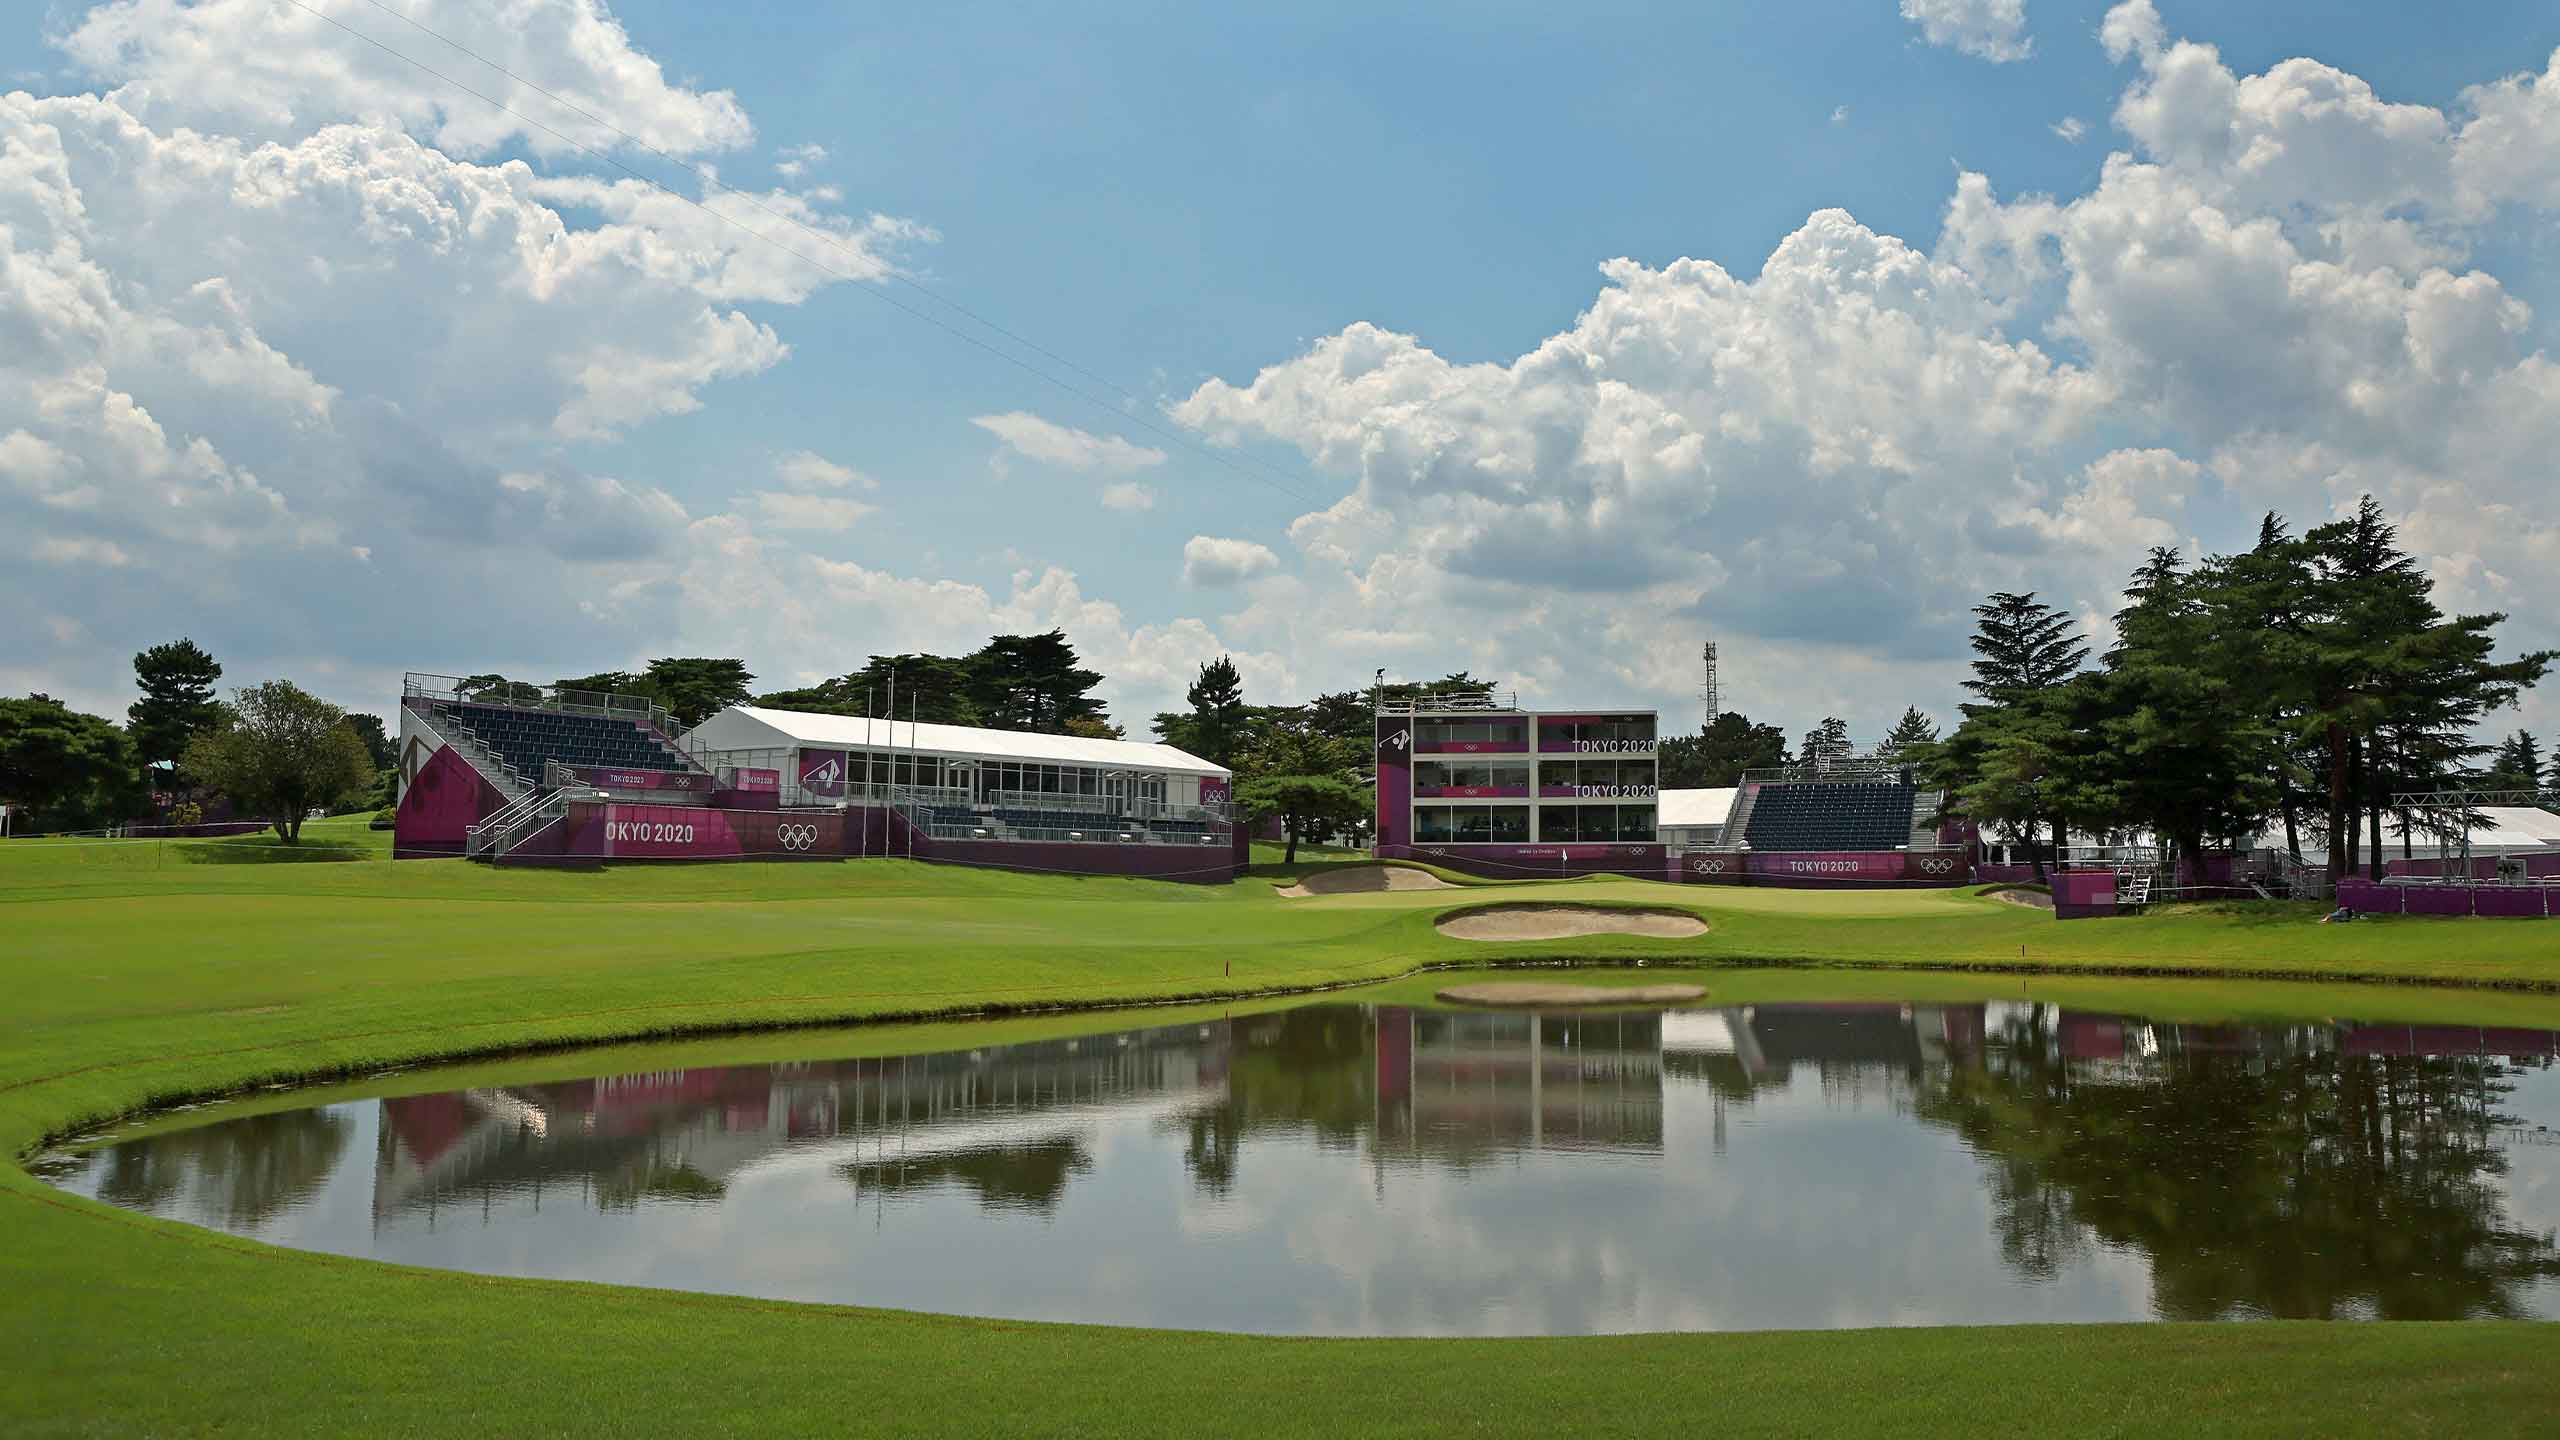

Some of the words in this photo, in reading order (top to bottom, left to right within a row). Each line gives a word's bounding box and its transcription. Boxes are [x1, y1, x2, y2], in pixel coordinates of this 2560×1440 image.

[1572, 740, 1618, 753] TOKYO
[1621, 740, 1655, 753] 2020
[1572, 785, 1619, 798] TOKYO
[1622, 785, 1656, 798] 2020
[606, 821, 651, 842] OKYO
[654, 823, 694, 843] 2020
[1790, 861, 1828, 872] TOKYO
[1830, 861, 1859, 872] 2020
